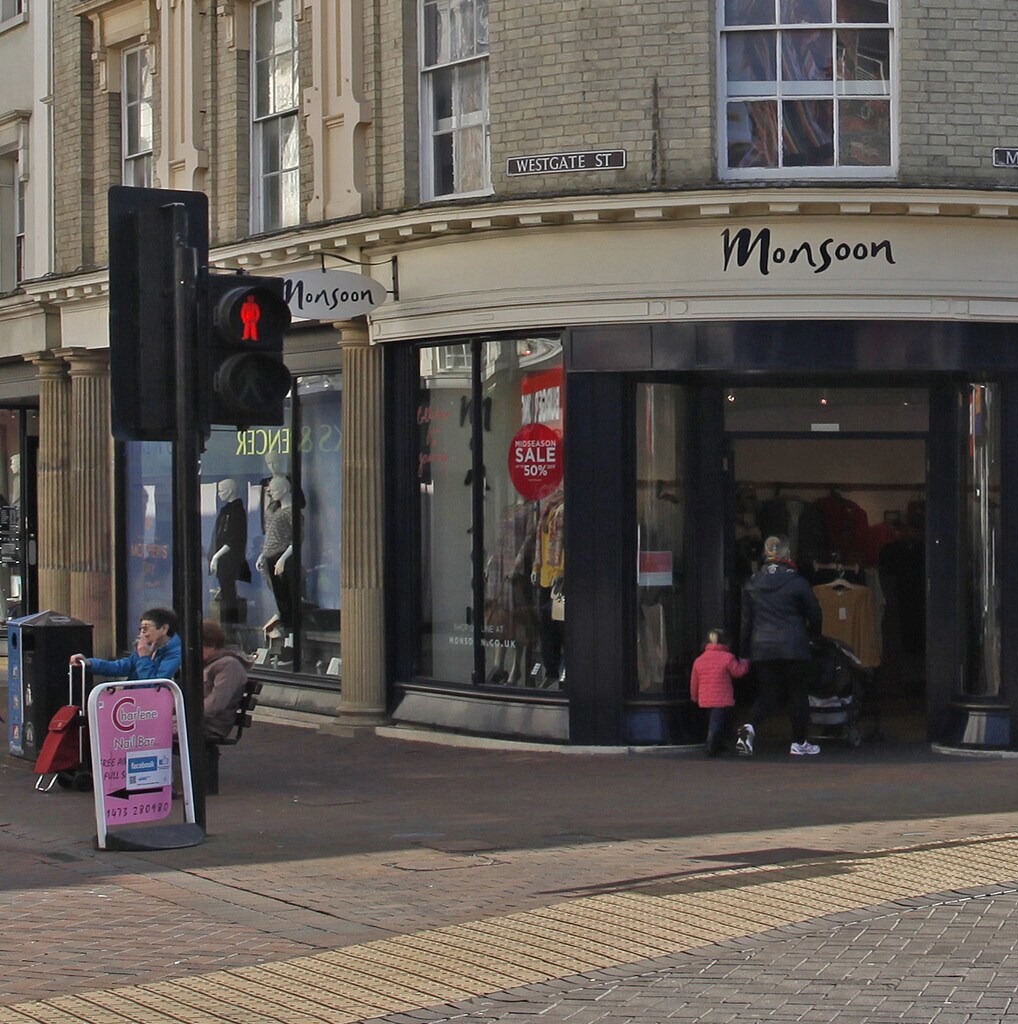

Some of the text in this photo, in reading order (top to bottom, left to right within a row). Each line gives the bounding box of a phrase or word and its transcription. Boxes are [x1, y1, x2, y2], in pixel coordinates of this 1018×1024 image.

[516, 153, 612, 172] WESTGATE ST
[720, 227, 896, 275] Monsoon
[515, 447, 556, 463] SALE
[524, 464, 548, 477] 50%
[449, 636, 516, 648] MONSON.CO.UK
[112, 697, 158, 732] Charlene
[114, 735, 156, 750] Nail Bar
[130, 761, 155, 769] facebook
[106, 807, 128, 819] 1473
